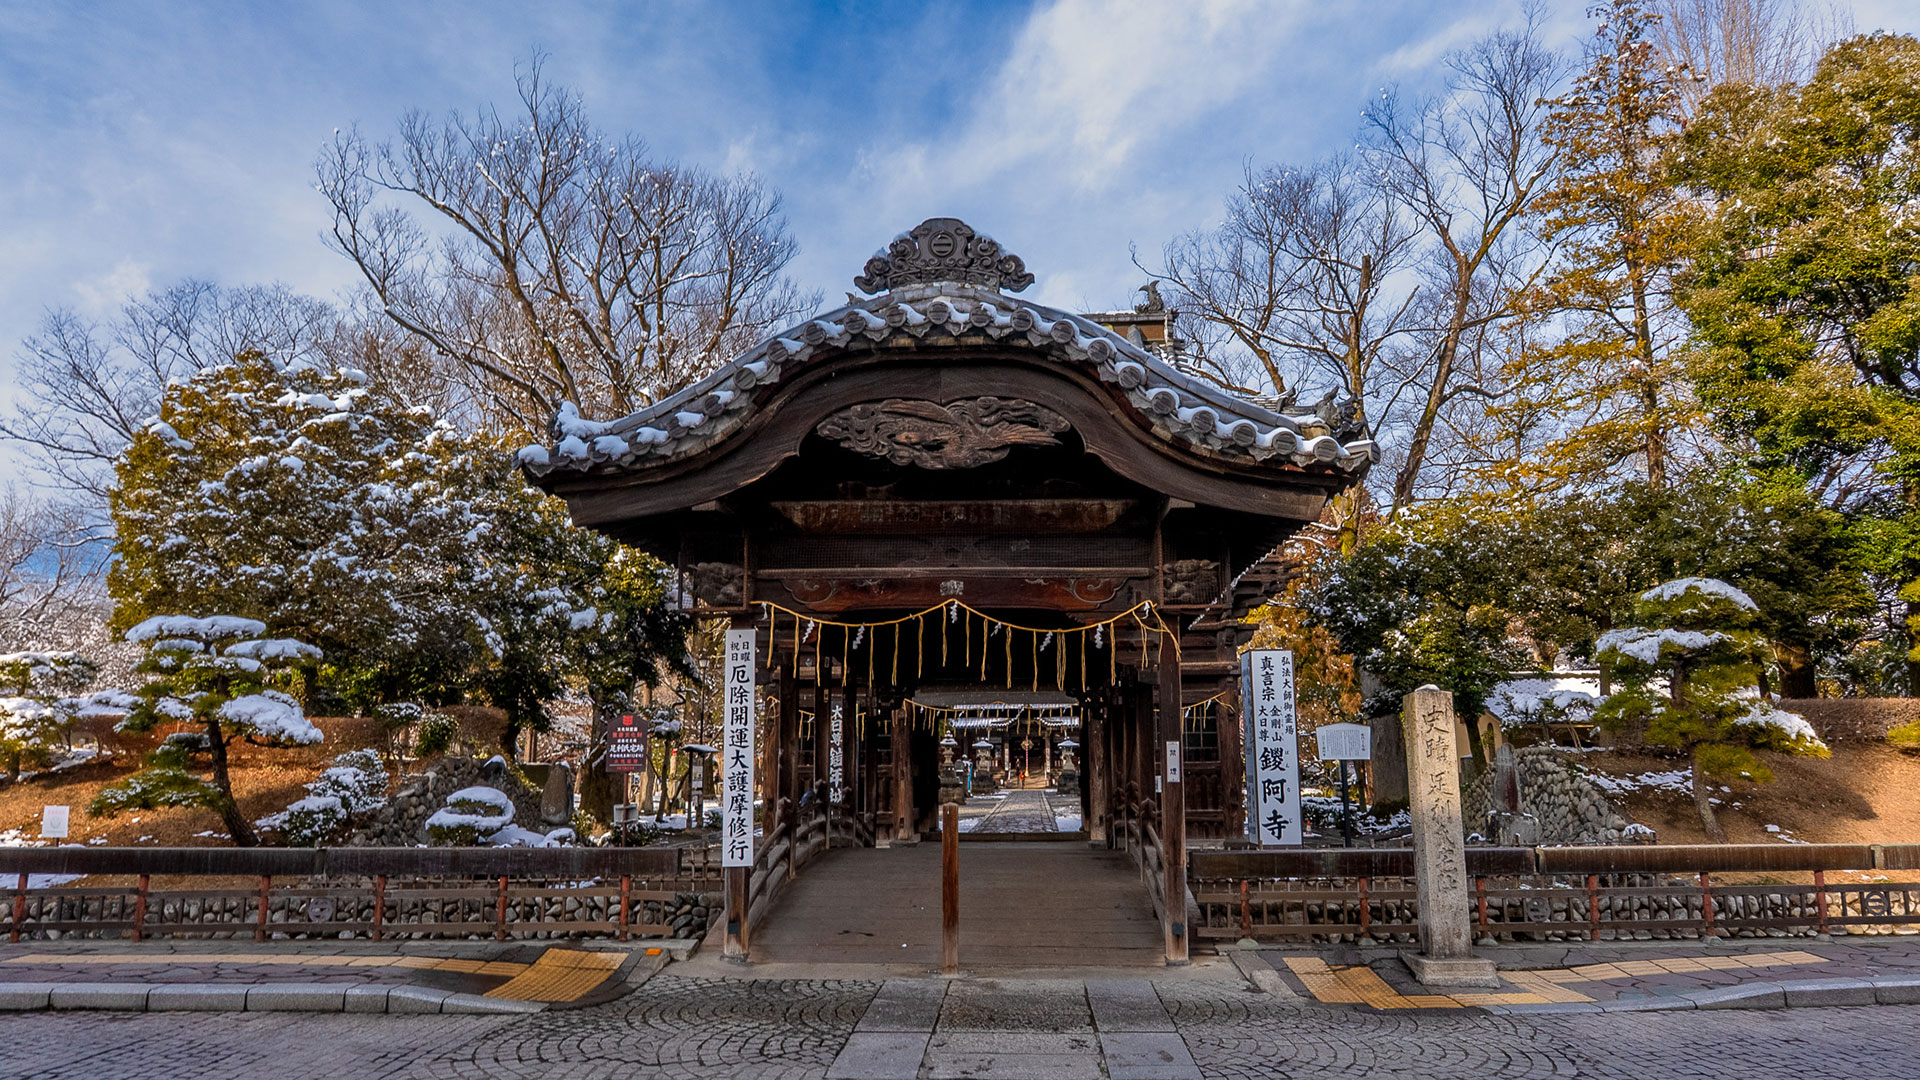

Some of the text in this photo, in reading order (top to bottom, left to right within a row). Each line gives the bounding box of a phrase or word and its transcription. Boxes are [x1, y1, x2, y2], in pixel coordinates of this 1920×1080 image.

[730, 641, 740, 661] 祝日
[741, 641, 750, 662] 日曜
[1260, 655, 1276, 702] 真言宗
[1258, 705, 1270, 742] 大日尊
[1270, 705, 1282, 742] 金剛山
[728, 665, 750, 861] 厄除開運大護摩修行
[1259, 747, 1289, 840] 鑁阿寺
